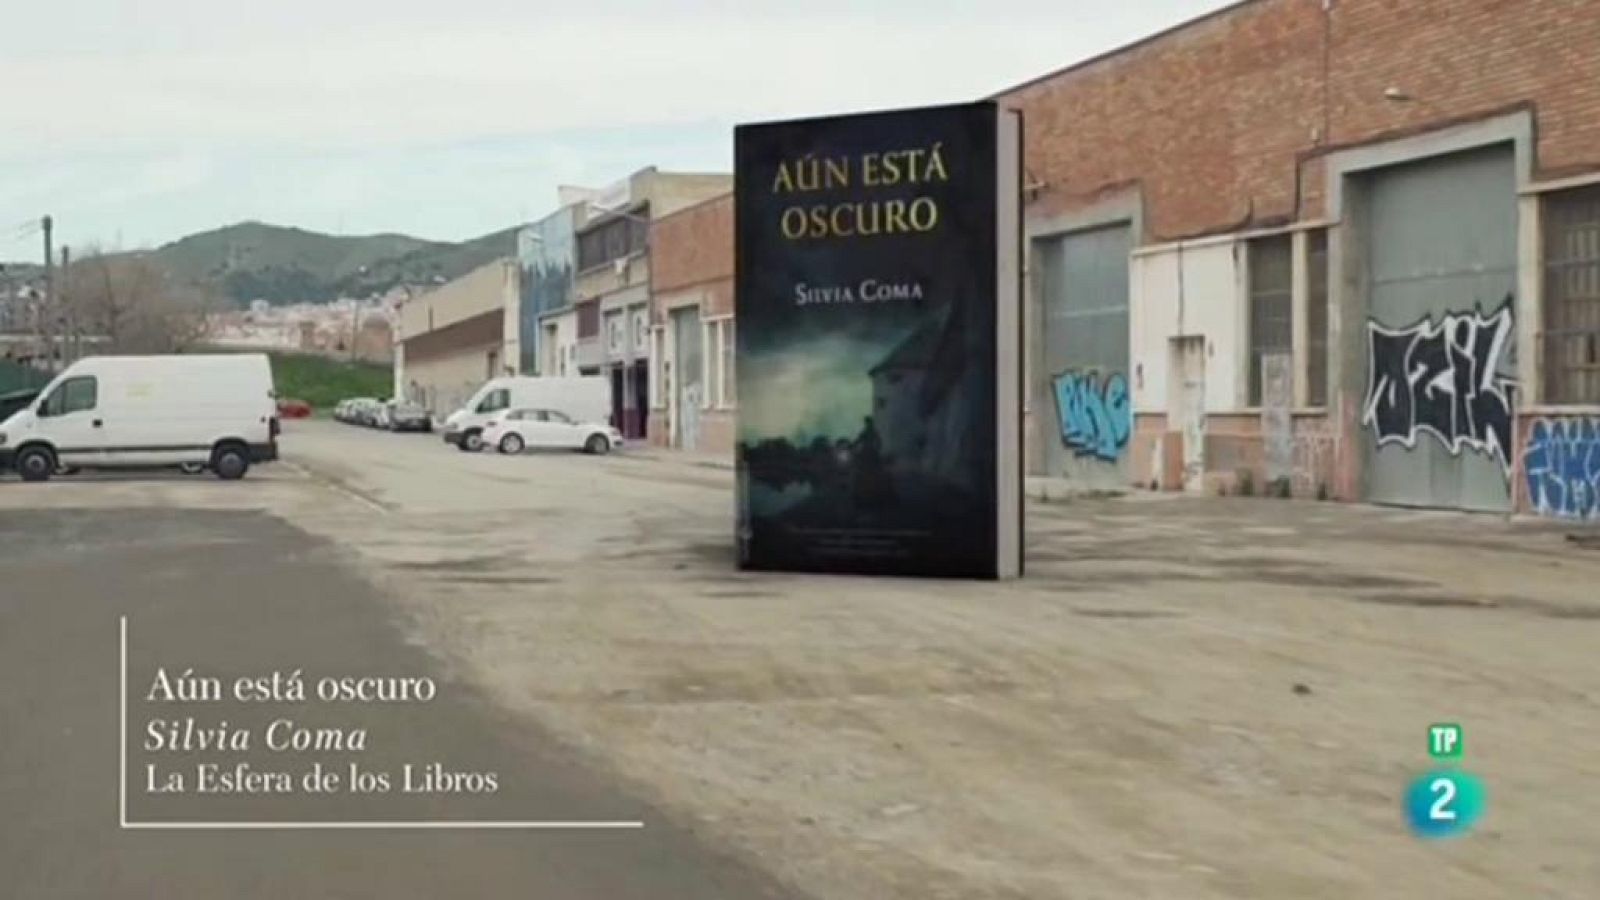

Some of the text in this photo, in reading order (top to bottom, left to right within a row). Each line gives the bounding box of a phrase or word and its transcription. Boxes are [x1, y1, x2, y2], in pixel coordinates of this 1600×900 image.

[774, 142, 948, 193] AÚN ESTÁ
[781, 197, 937, 239] OSCURO
